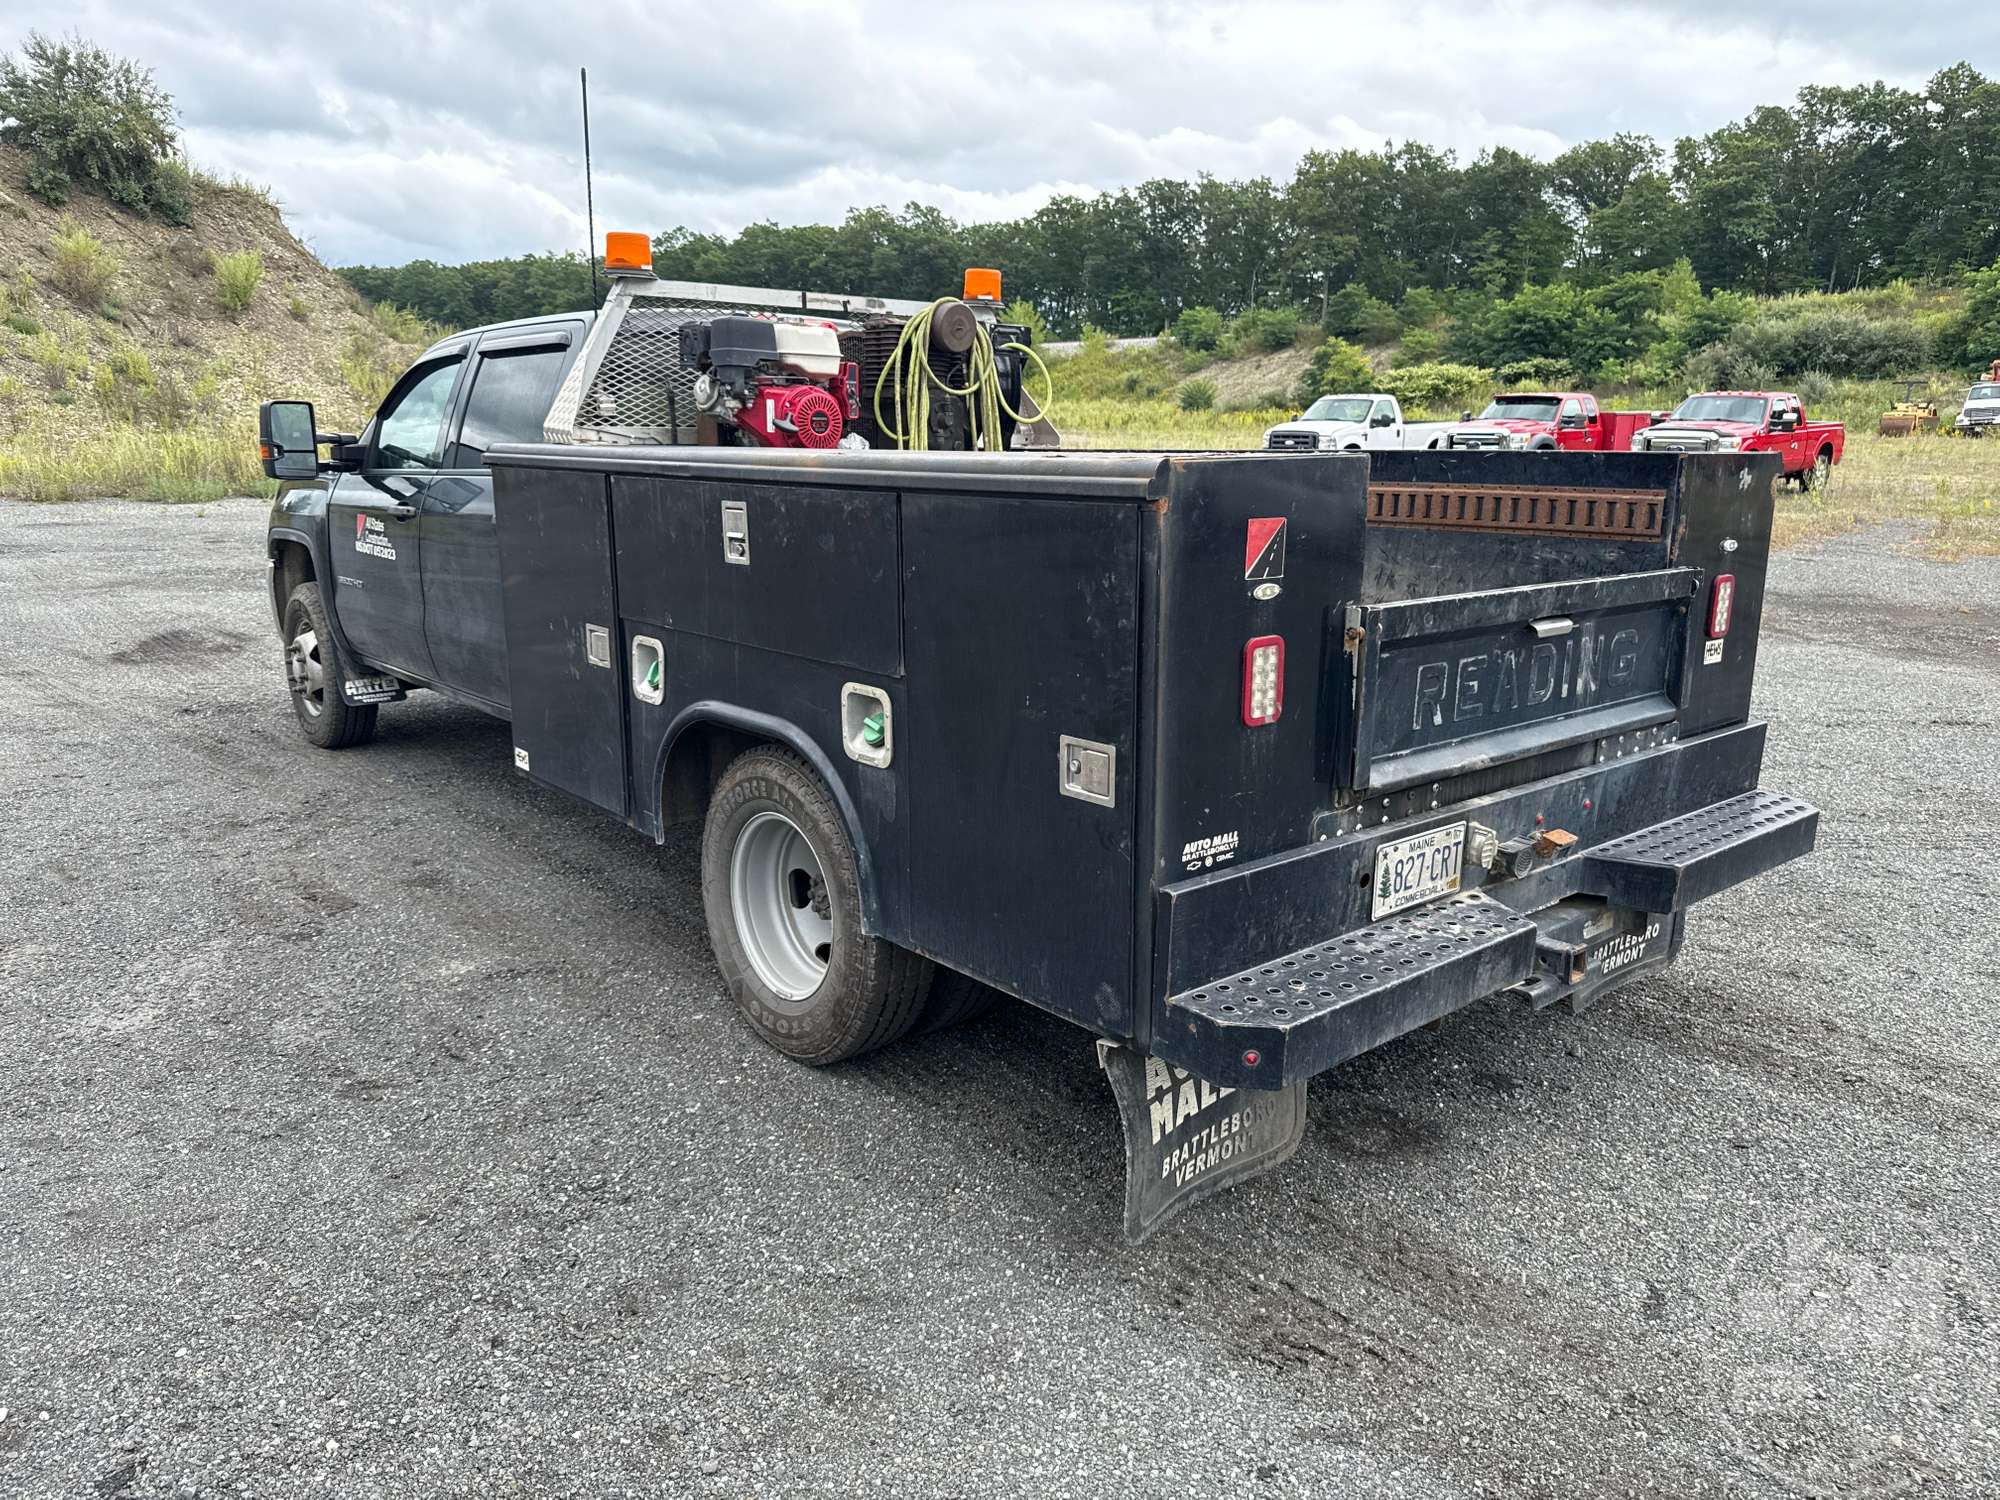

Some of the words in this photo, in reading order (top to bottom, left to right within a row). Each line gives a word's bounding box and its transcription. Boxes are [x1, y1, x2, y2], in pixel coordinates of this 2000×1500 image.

[1412, 627, 1639, 731] READING
[1183, 838, 1211, 855] AUTO
[1212, 830, 1239, 847] MALL
[1216, 851, 1235, 862] GMC
[1408, 836, 1436, 853] MAINE
[1161, 1099, 1276, 1180] BRATTLEBORO
[1174, 1131, 1255, 1188] VERMONT
